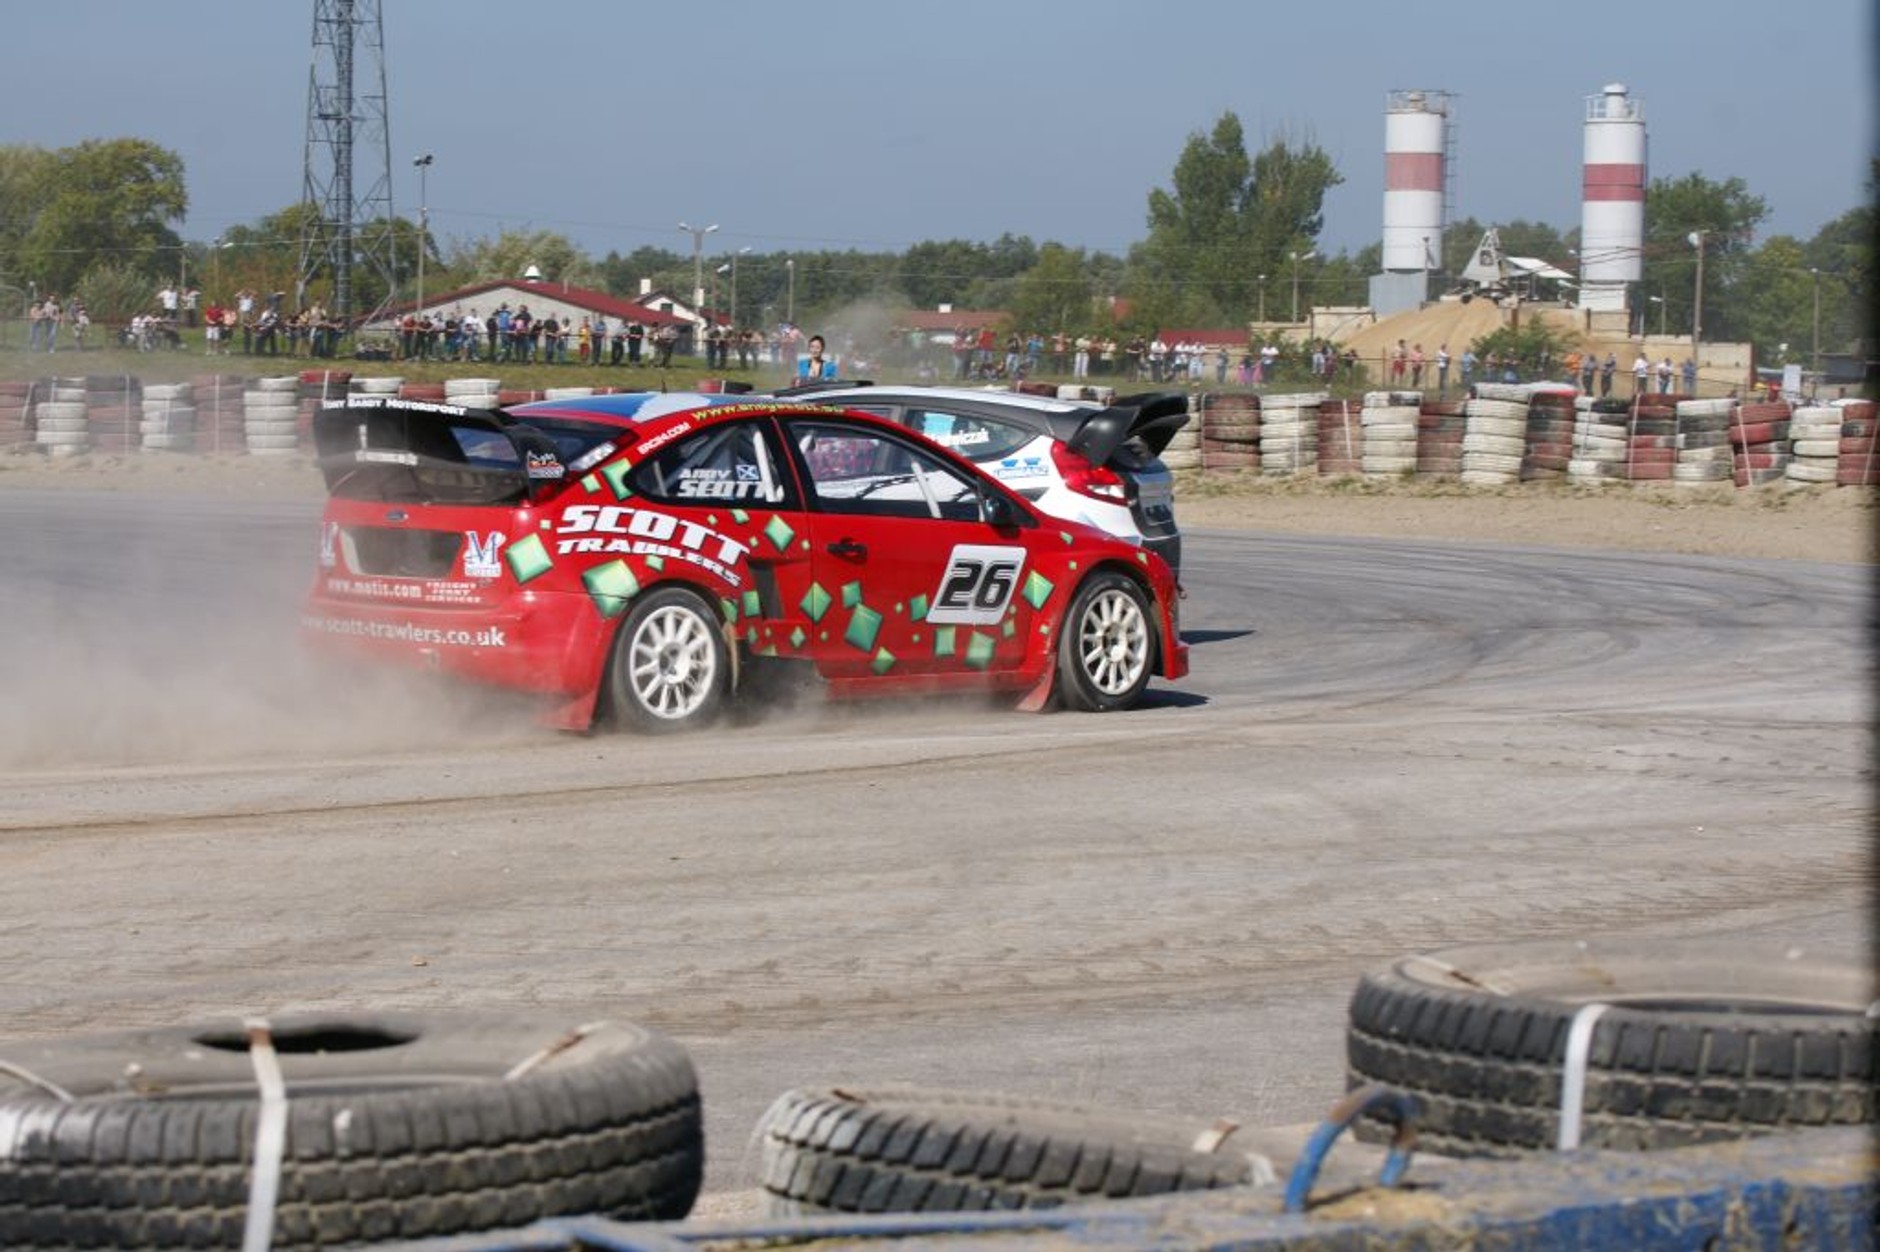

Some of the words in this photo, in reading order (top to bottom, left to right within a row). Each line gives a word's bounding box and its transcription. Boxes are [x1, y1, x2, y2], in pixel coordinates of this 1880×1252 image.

[386, 399, 467, 415] MOTORSPORT
[677, 480, 768, 498] SCOTT
[678, 468, 731, 480] ANDY
[556, 504, 751, 566] SCOTT
[556, 537, 742, 587] TRAWLERS
[937, 560, 1016, 611] 26
